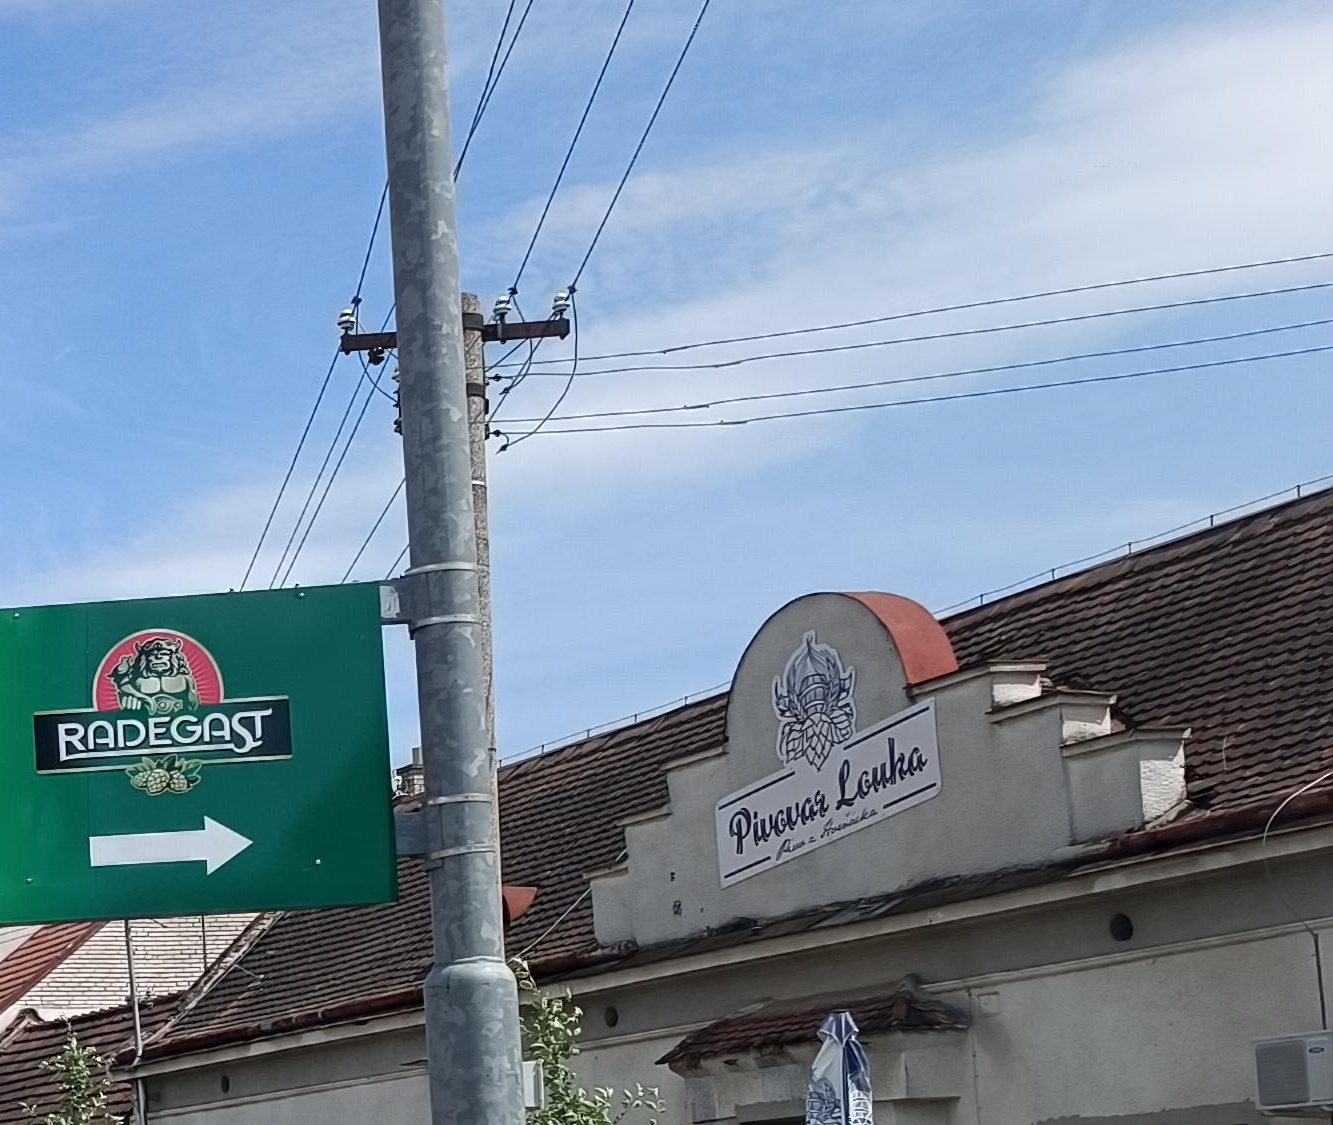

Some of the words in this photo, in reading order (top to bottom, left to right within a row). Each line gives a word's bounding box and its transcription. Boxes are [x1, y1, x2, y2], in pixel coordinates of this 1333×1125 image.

[58, 707, 273, 762] RADEGAST
[729, 790, 829, 854] Pivovar
[836, 737, 927, 810] Louka
